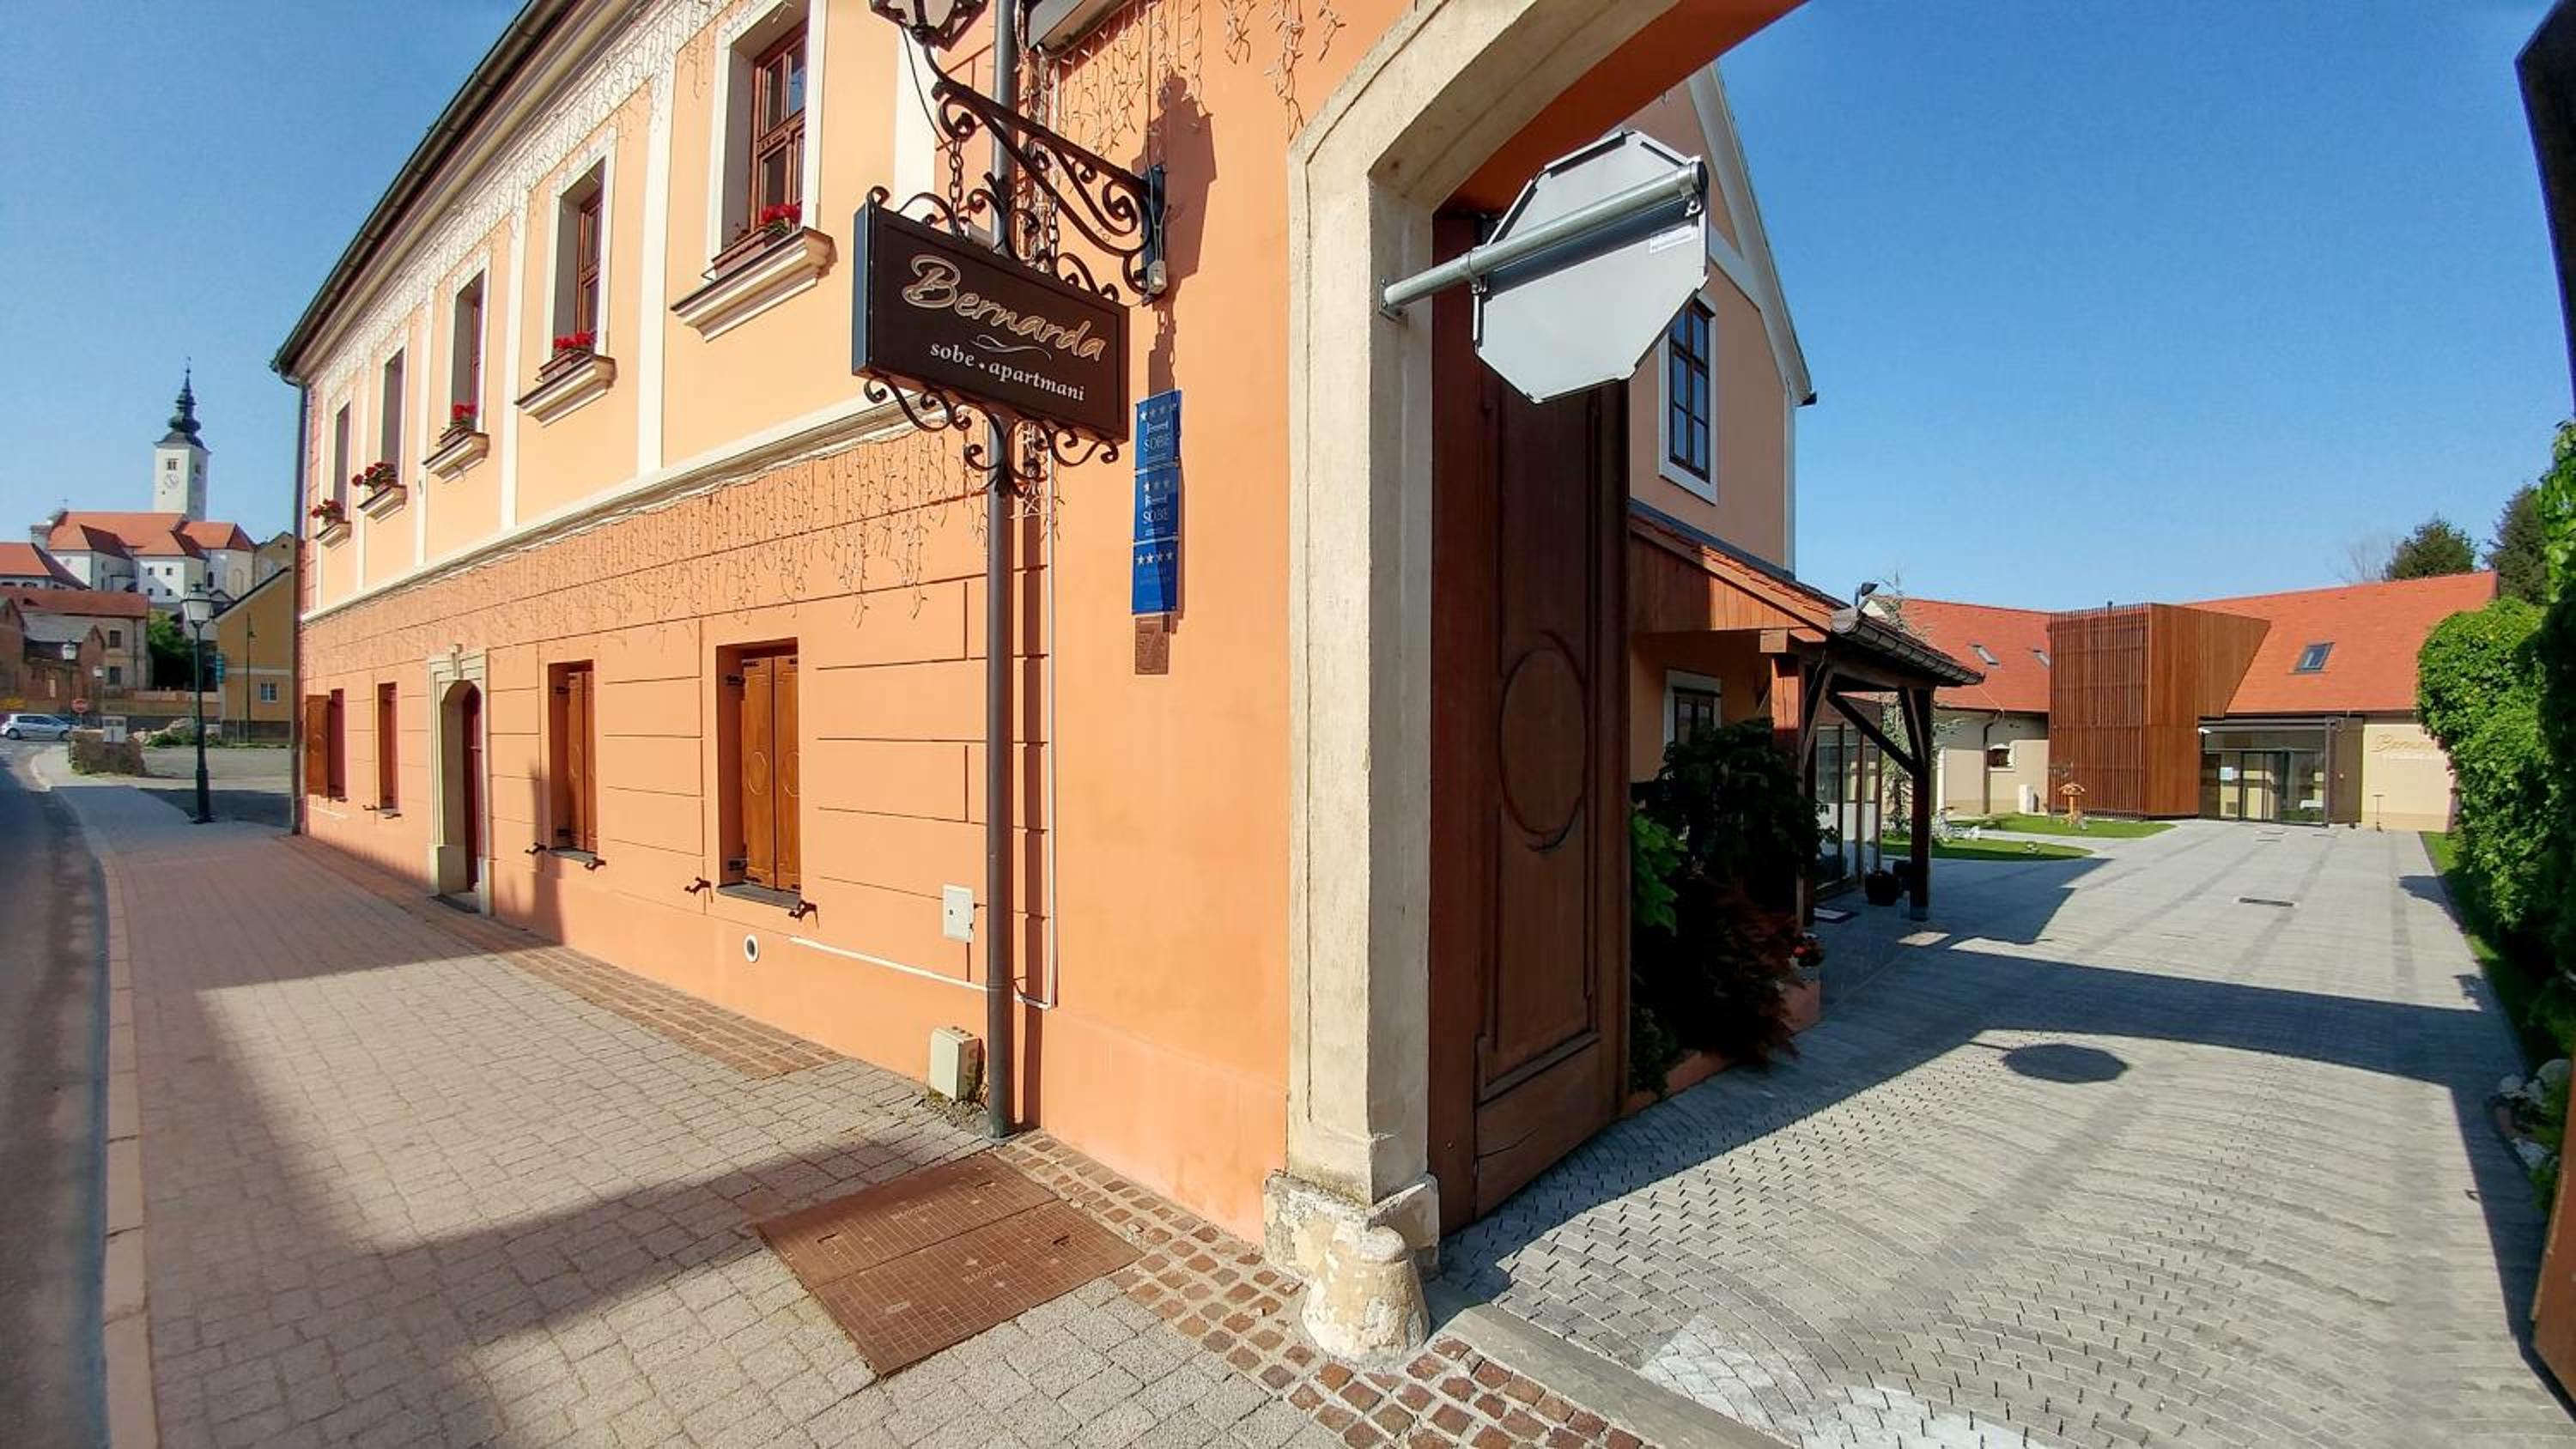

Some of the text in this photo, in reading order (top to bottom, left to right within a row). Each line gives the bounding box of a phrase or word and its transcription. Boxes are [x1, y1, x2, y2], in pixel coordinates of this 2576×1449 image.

[902, 254, 1106, 361] Bernarda
[930, 343, 1085, 402] sobe apartmani
